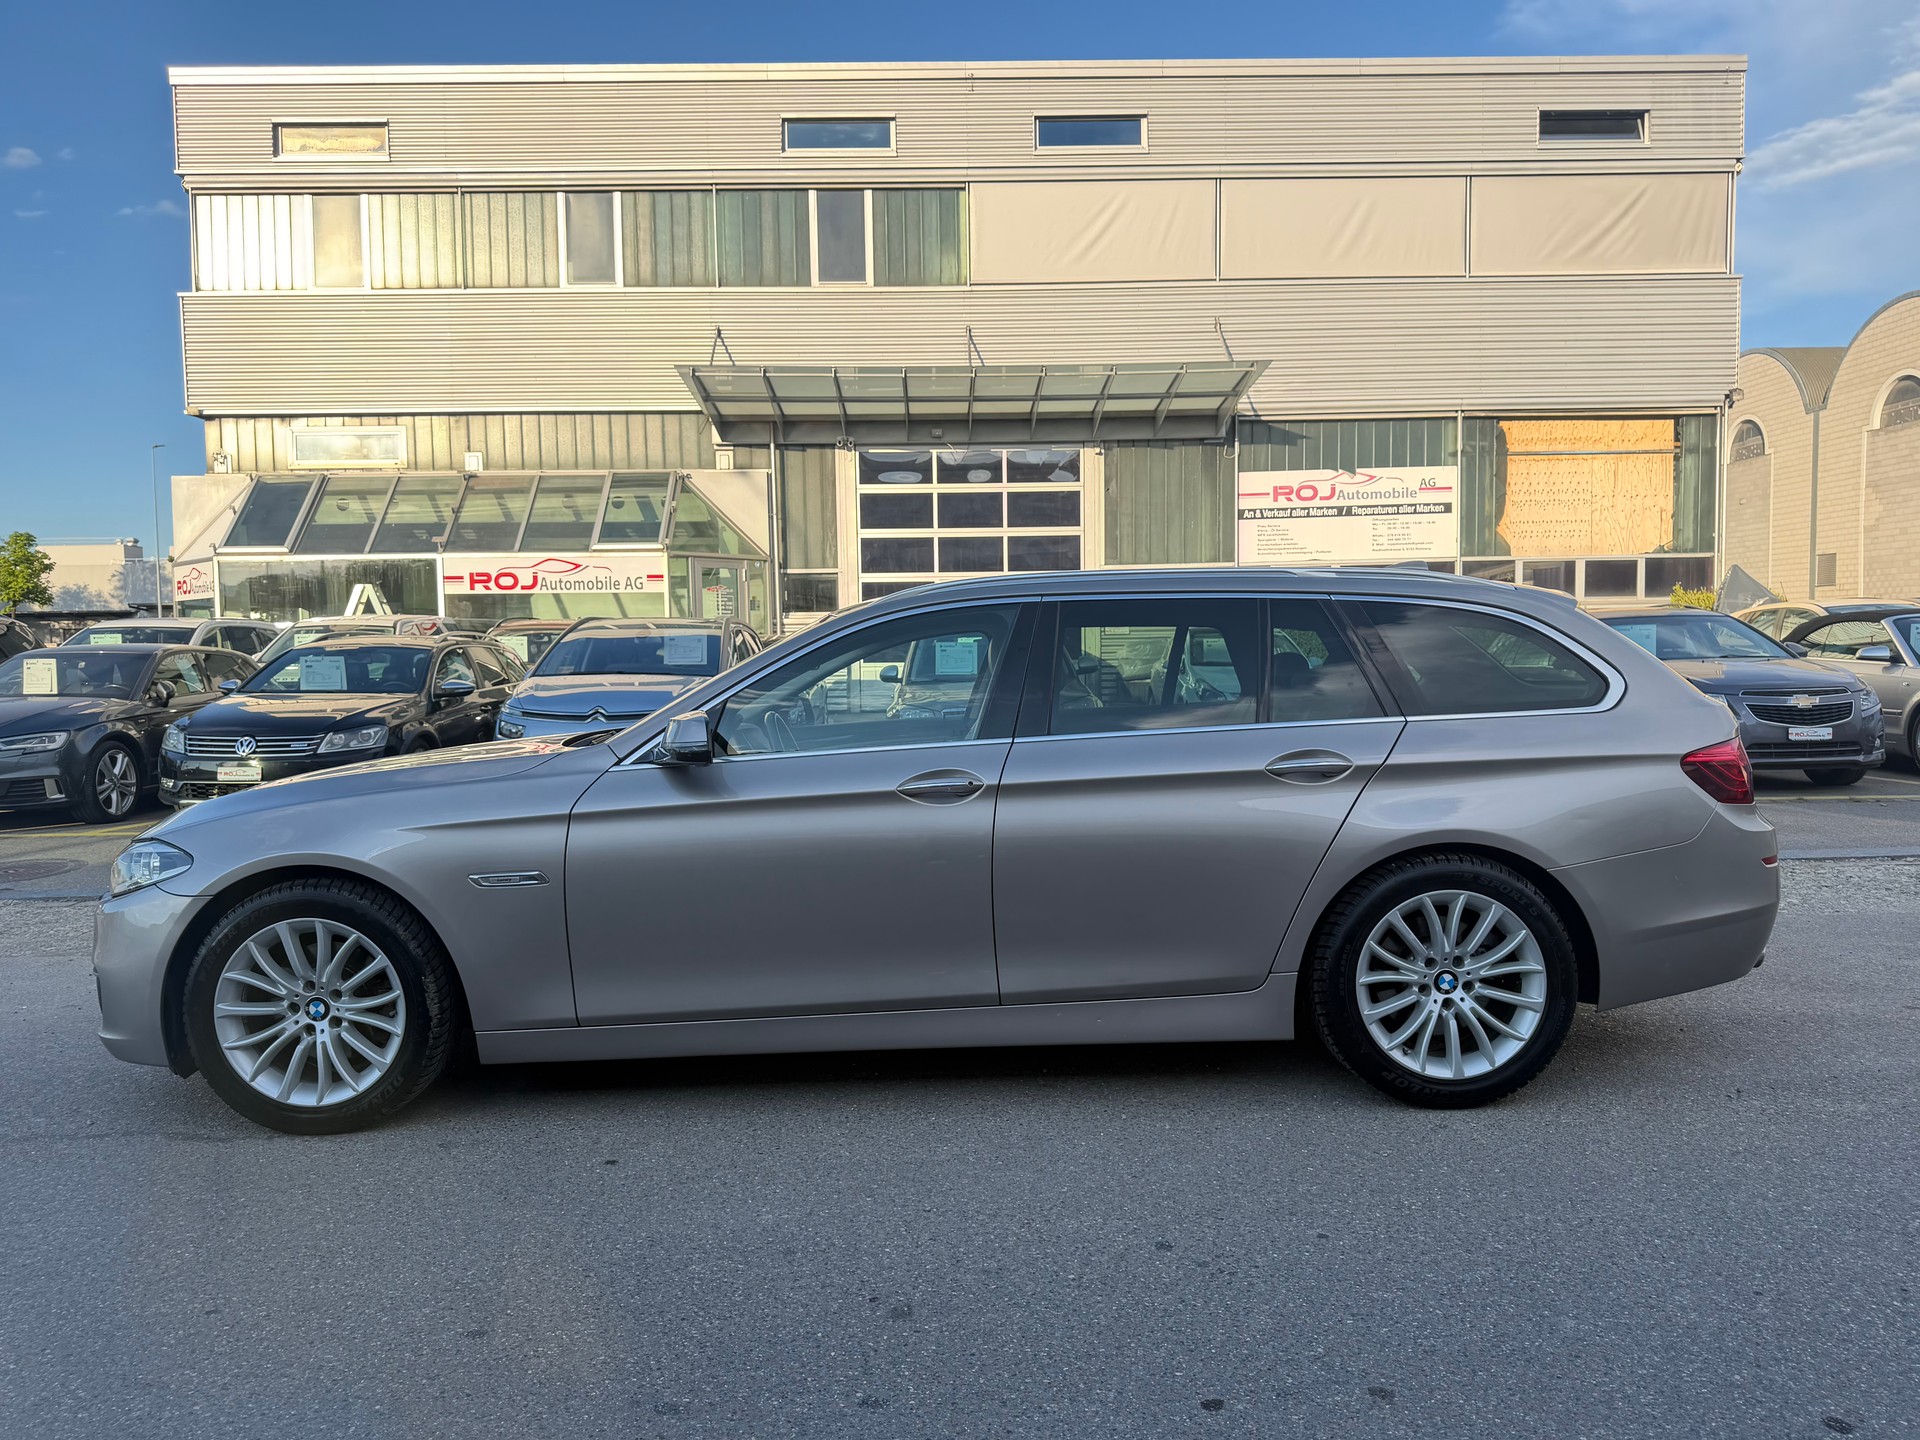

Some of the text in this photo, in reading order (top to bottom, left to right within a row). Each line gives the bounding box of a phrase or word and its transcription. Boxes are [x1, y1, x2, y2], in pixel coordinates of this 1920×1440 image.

[1273, 477, 1436, 502] ROJ Automobile AG
[1243, 509, 1254, 519] An
[1255, 509, 1262, 519] &
[1262, 508, 1291, 518] Verkauf
[1291, 507, 1308, 517] aller
[1309, 507, 1338, 516] Marken
[1351, 505, 1398, 516] Reparaturen
[1398, 504, 1415, 514] aller
[1416, 503, 1445, 513] Marken
[177, 579, 192, 596] ROJ
[469, 572, 643, 591] ROJ Automobile AG
[1478, 875, 1530, 905] SPORT
